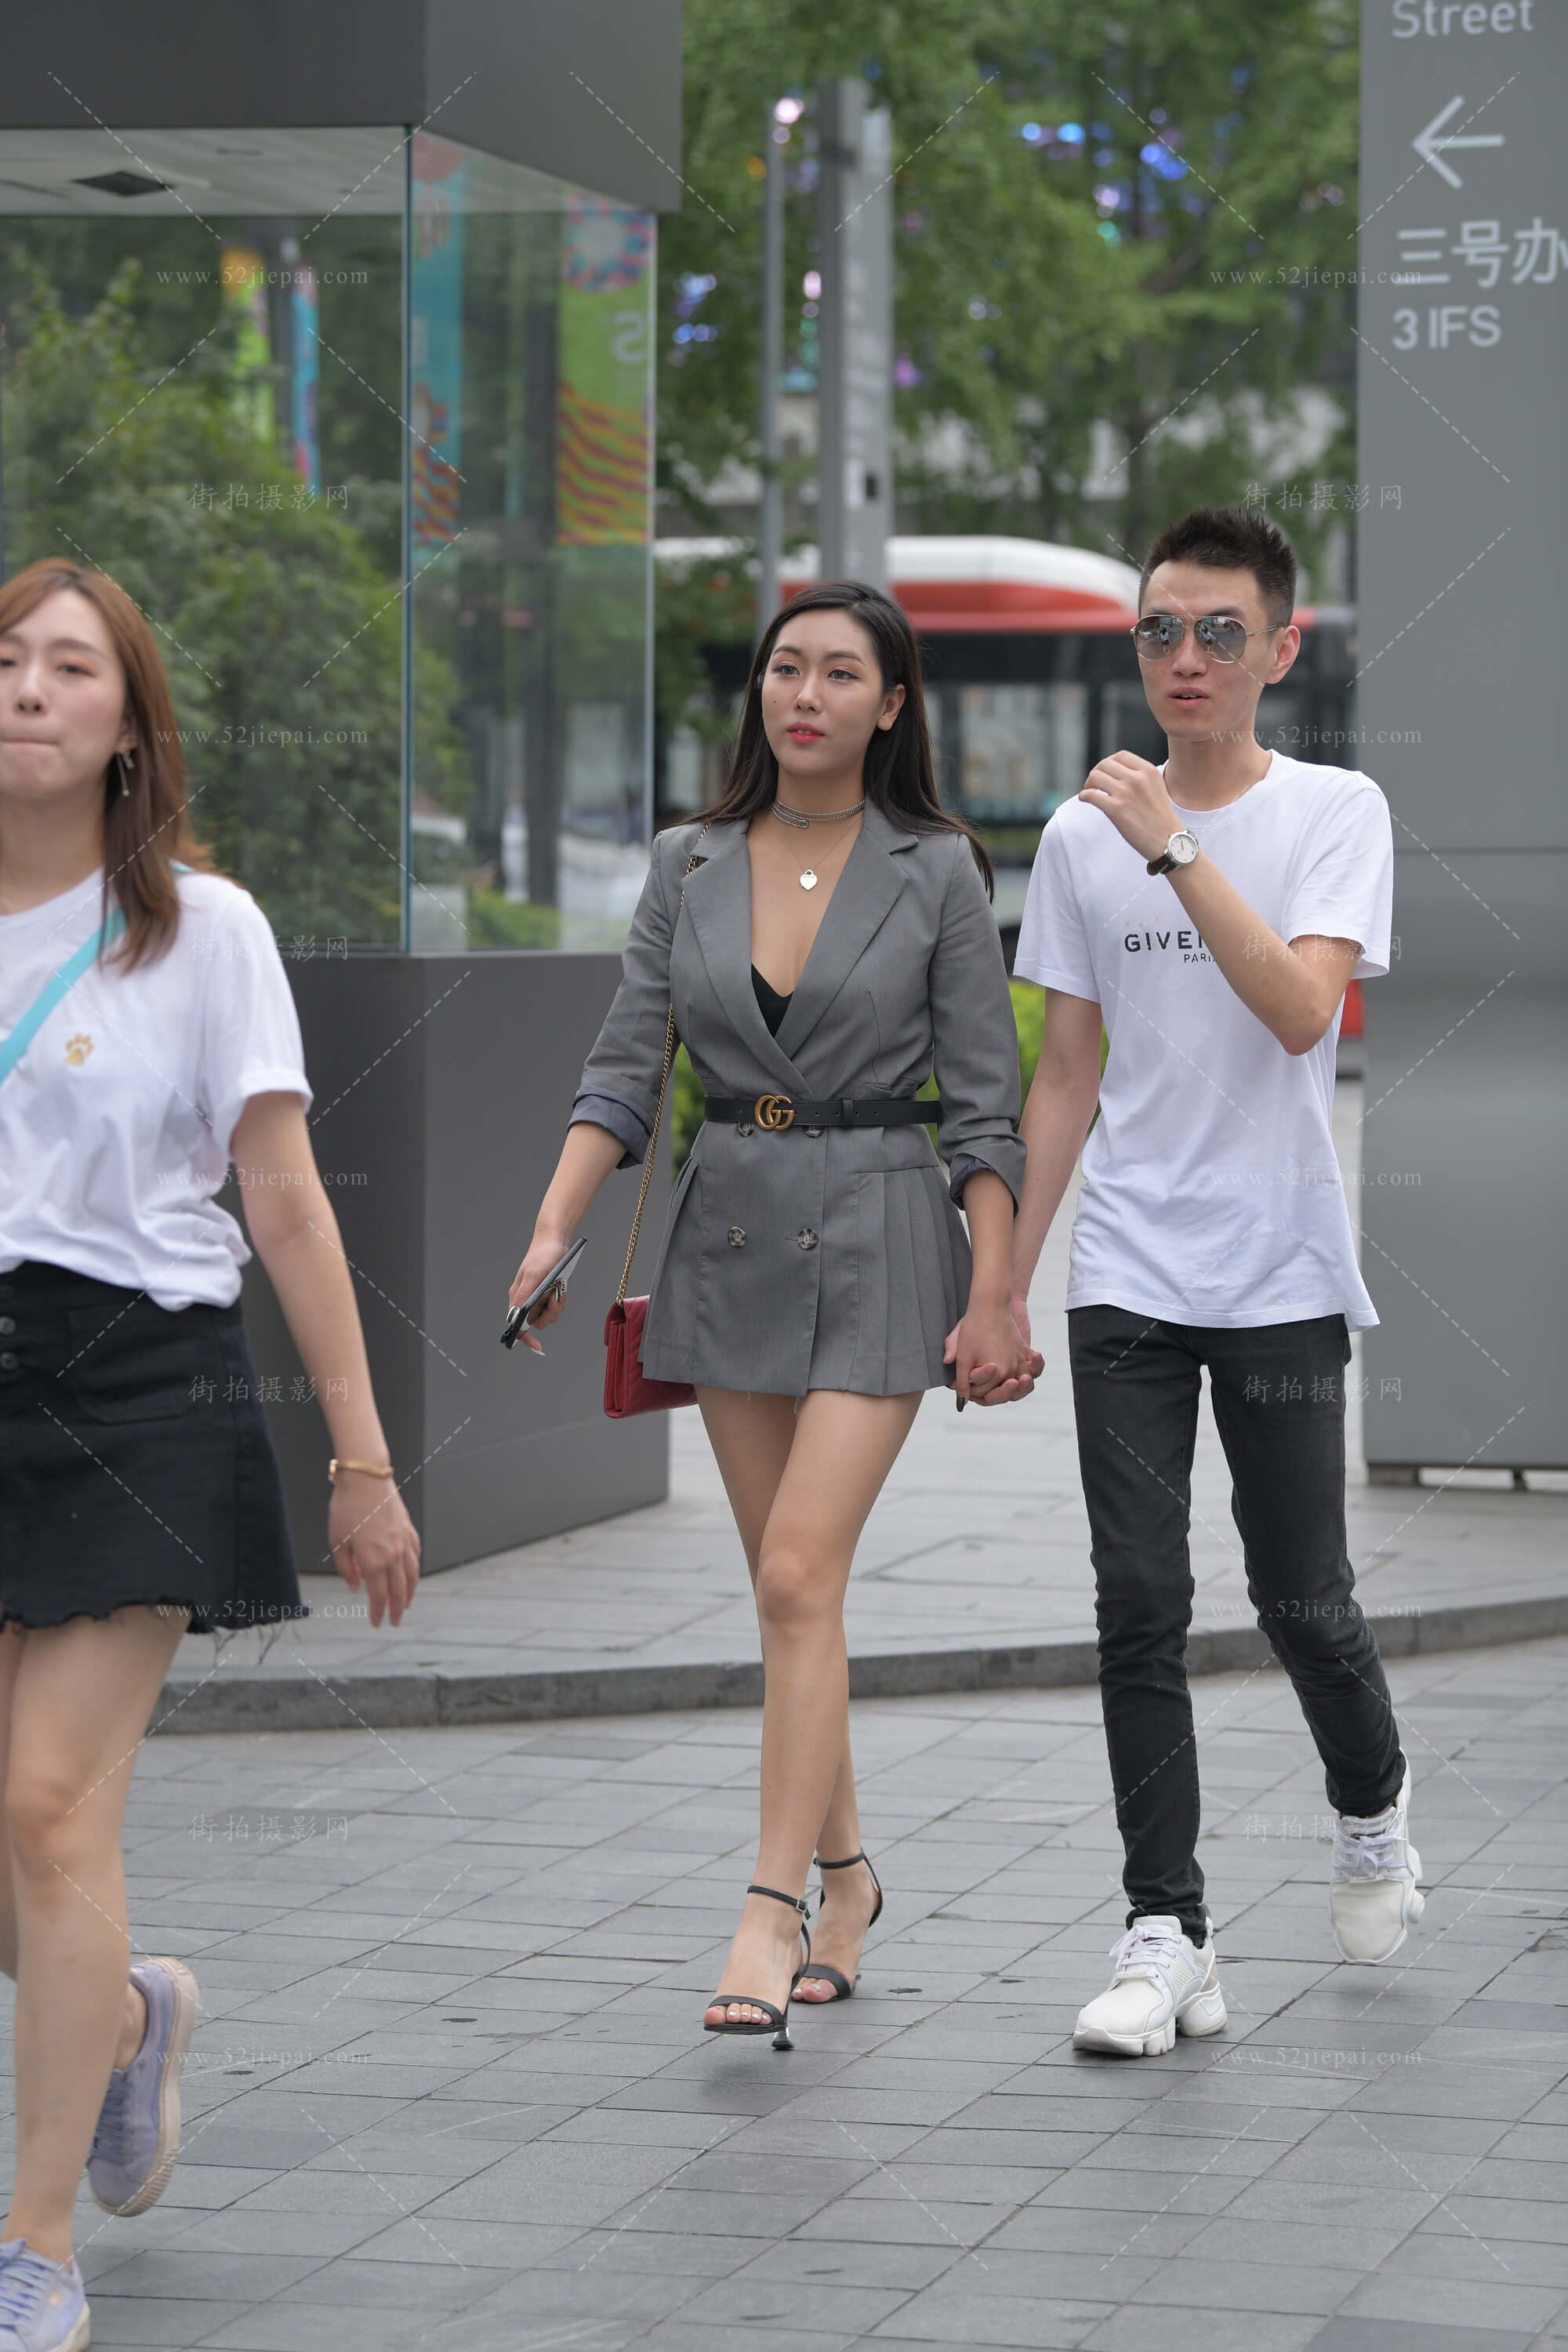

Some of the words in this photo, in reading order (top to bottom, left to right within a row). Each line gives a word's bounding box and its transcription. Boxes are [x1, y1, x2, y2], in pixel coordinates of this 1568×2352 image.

[1391, 0, 1534, 38] Street
[1124, 931, 1203, 953] GIVE
[1184, 953, 1215, 963] PARI
